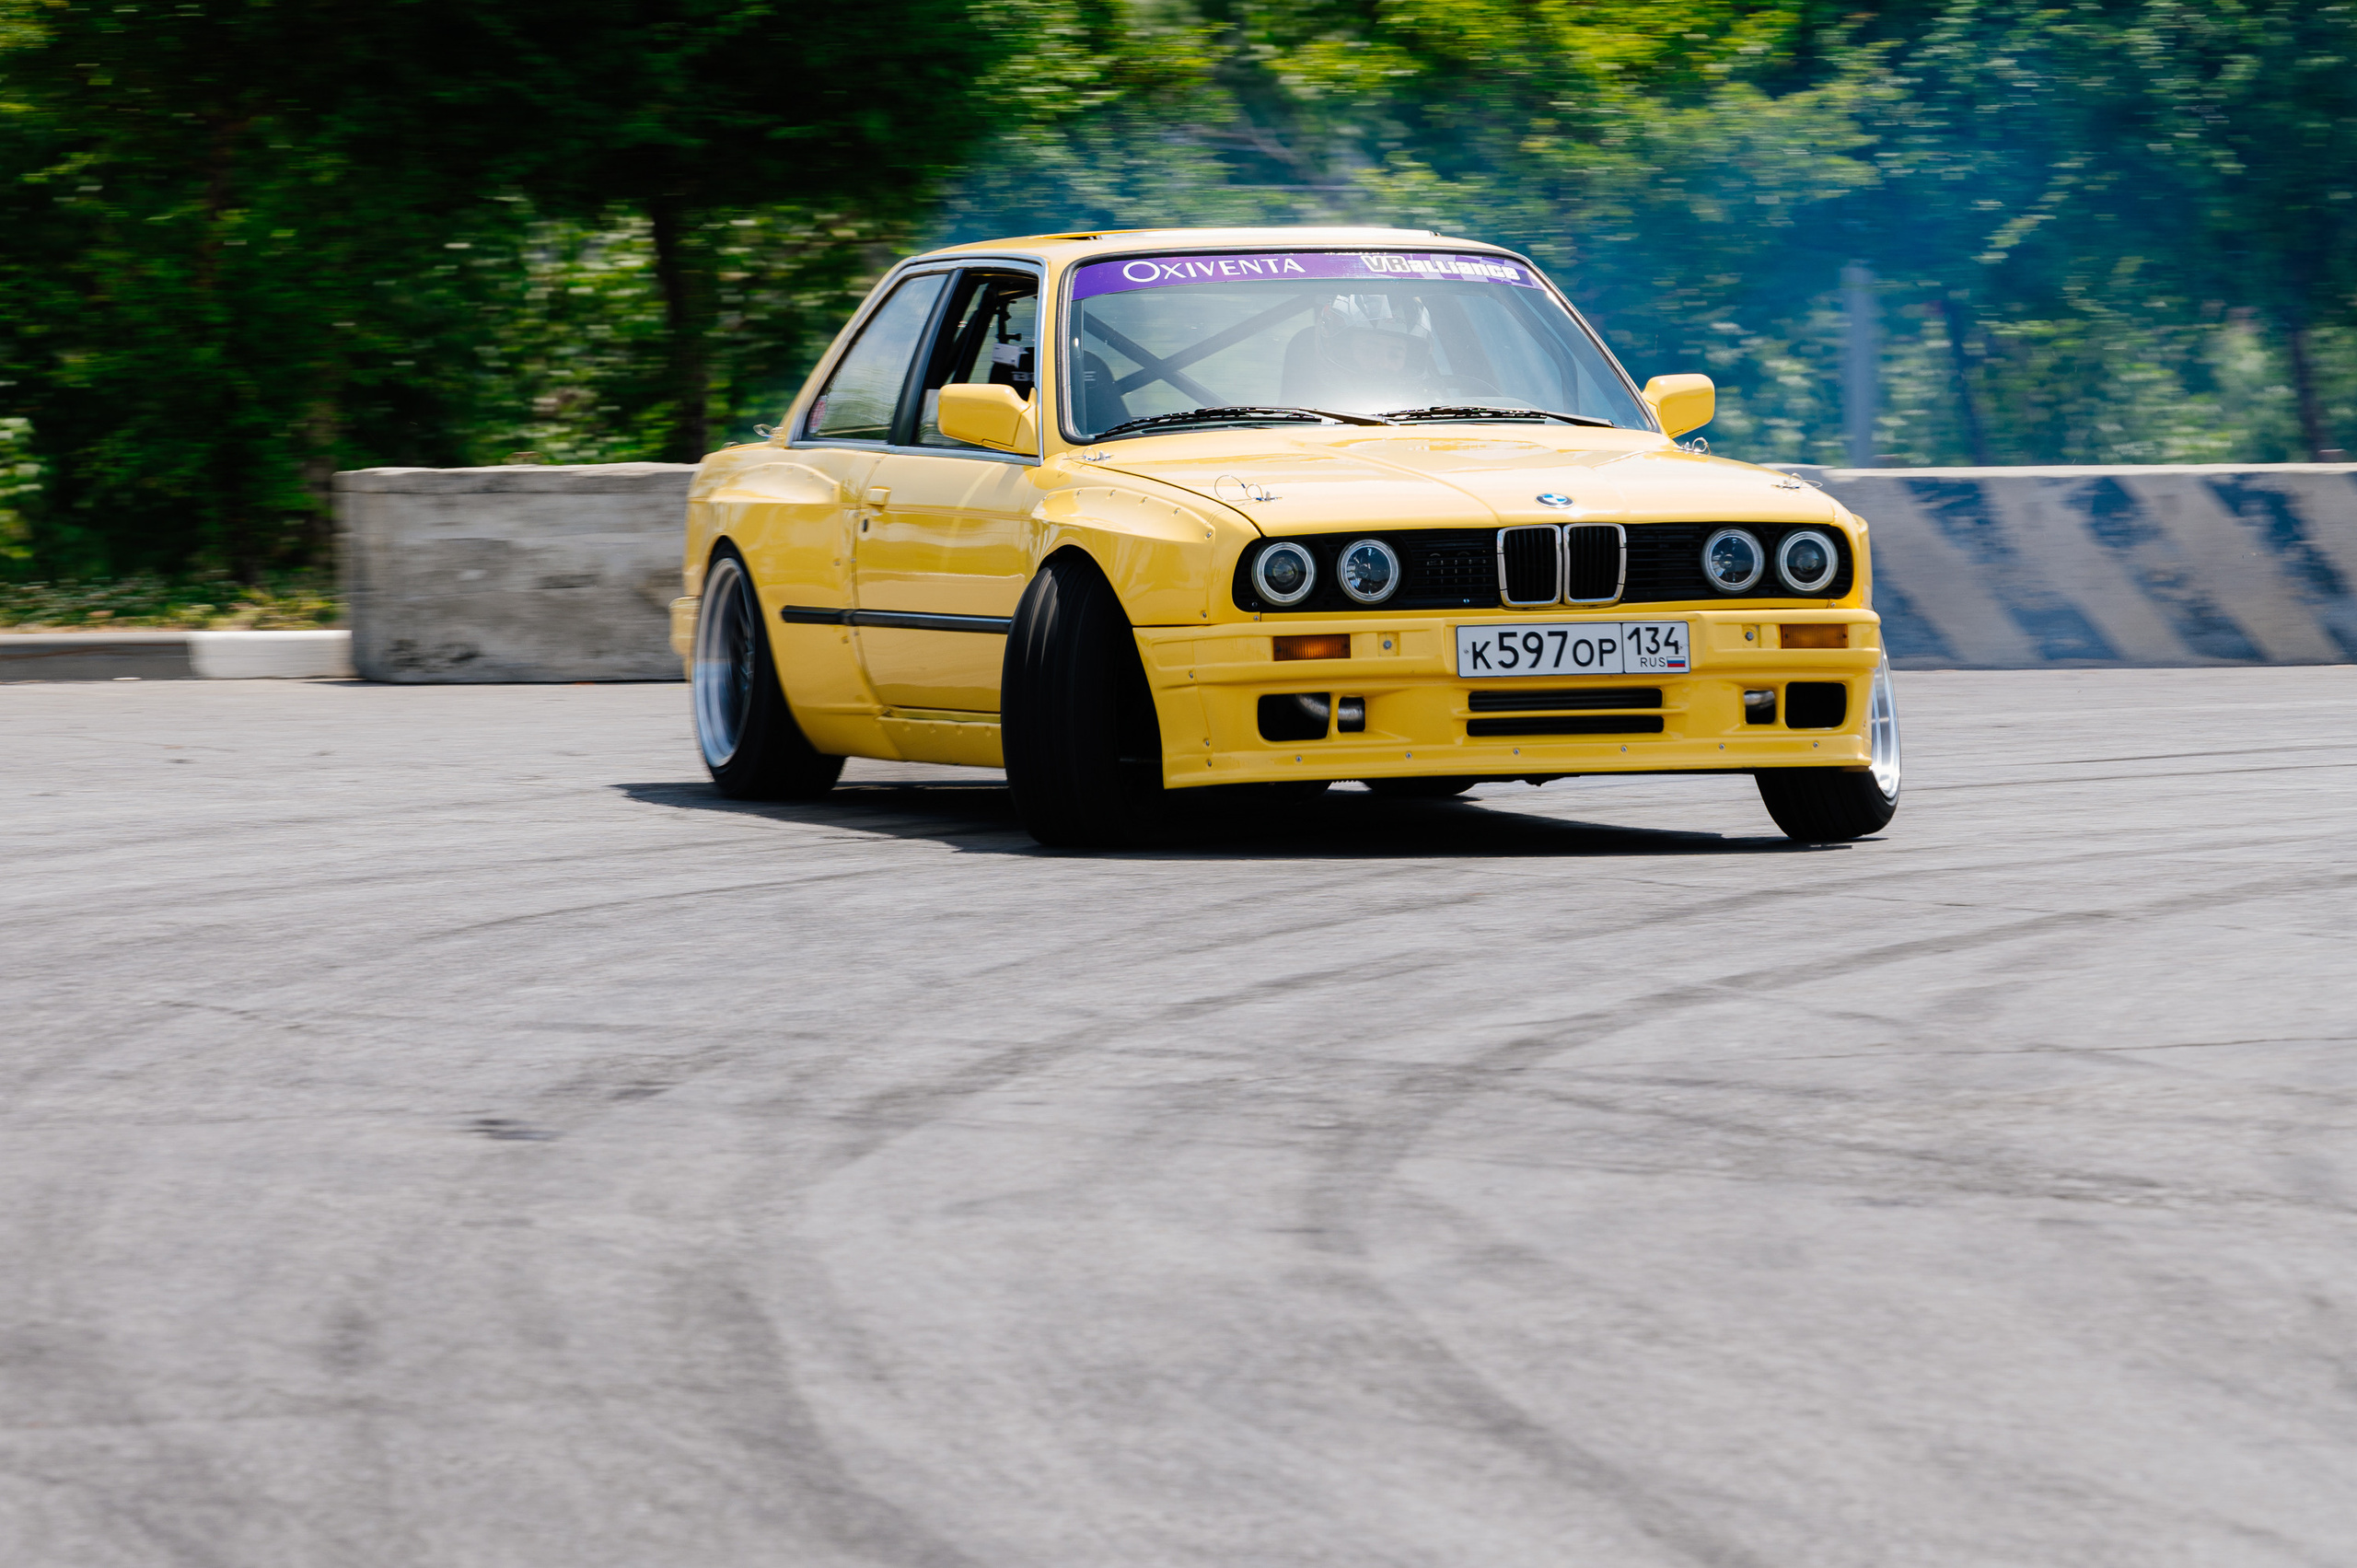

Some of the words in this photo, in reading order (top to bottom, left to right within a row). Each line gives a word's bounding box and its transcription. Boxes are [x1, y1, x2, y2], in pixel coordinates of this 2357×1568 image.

[1122, 258, 1306, 283] OXIVENTA
[1627, 627, 1679, 656] 134
[1640, 656, 1666, 668] RUS
